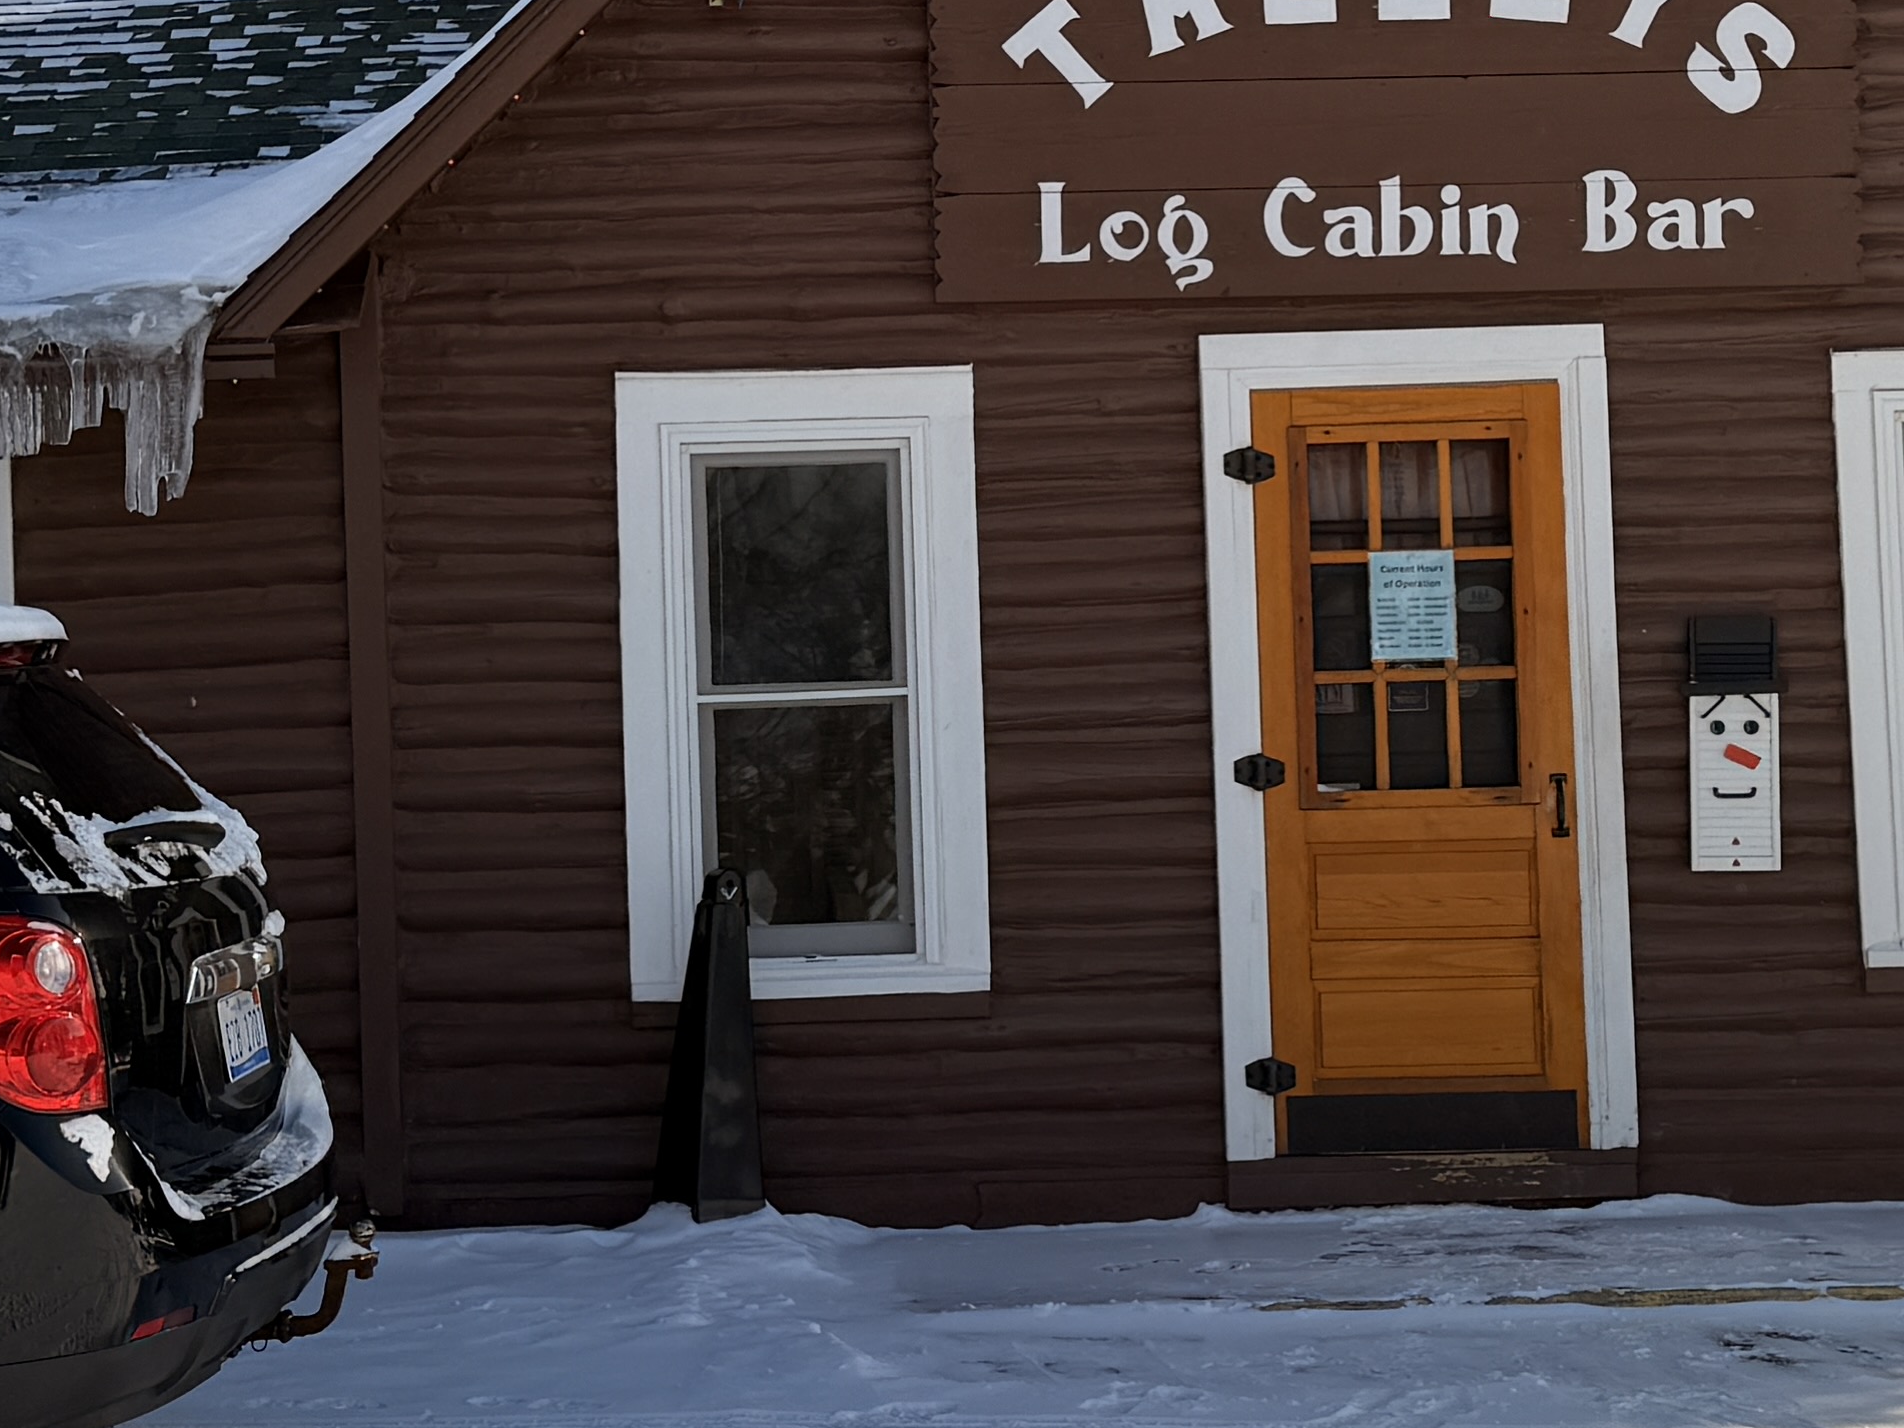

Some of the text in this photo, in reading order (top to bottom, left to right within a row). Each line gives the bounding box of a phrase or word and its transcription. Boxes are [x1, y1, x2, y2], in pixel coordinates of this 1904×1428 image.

[1036, 169, 1755, 293] Log Cabin Bar
[1380, 563, 1444, 573] Current Hours
[1383, 579, 1442, 589] of Operation
